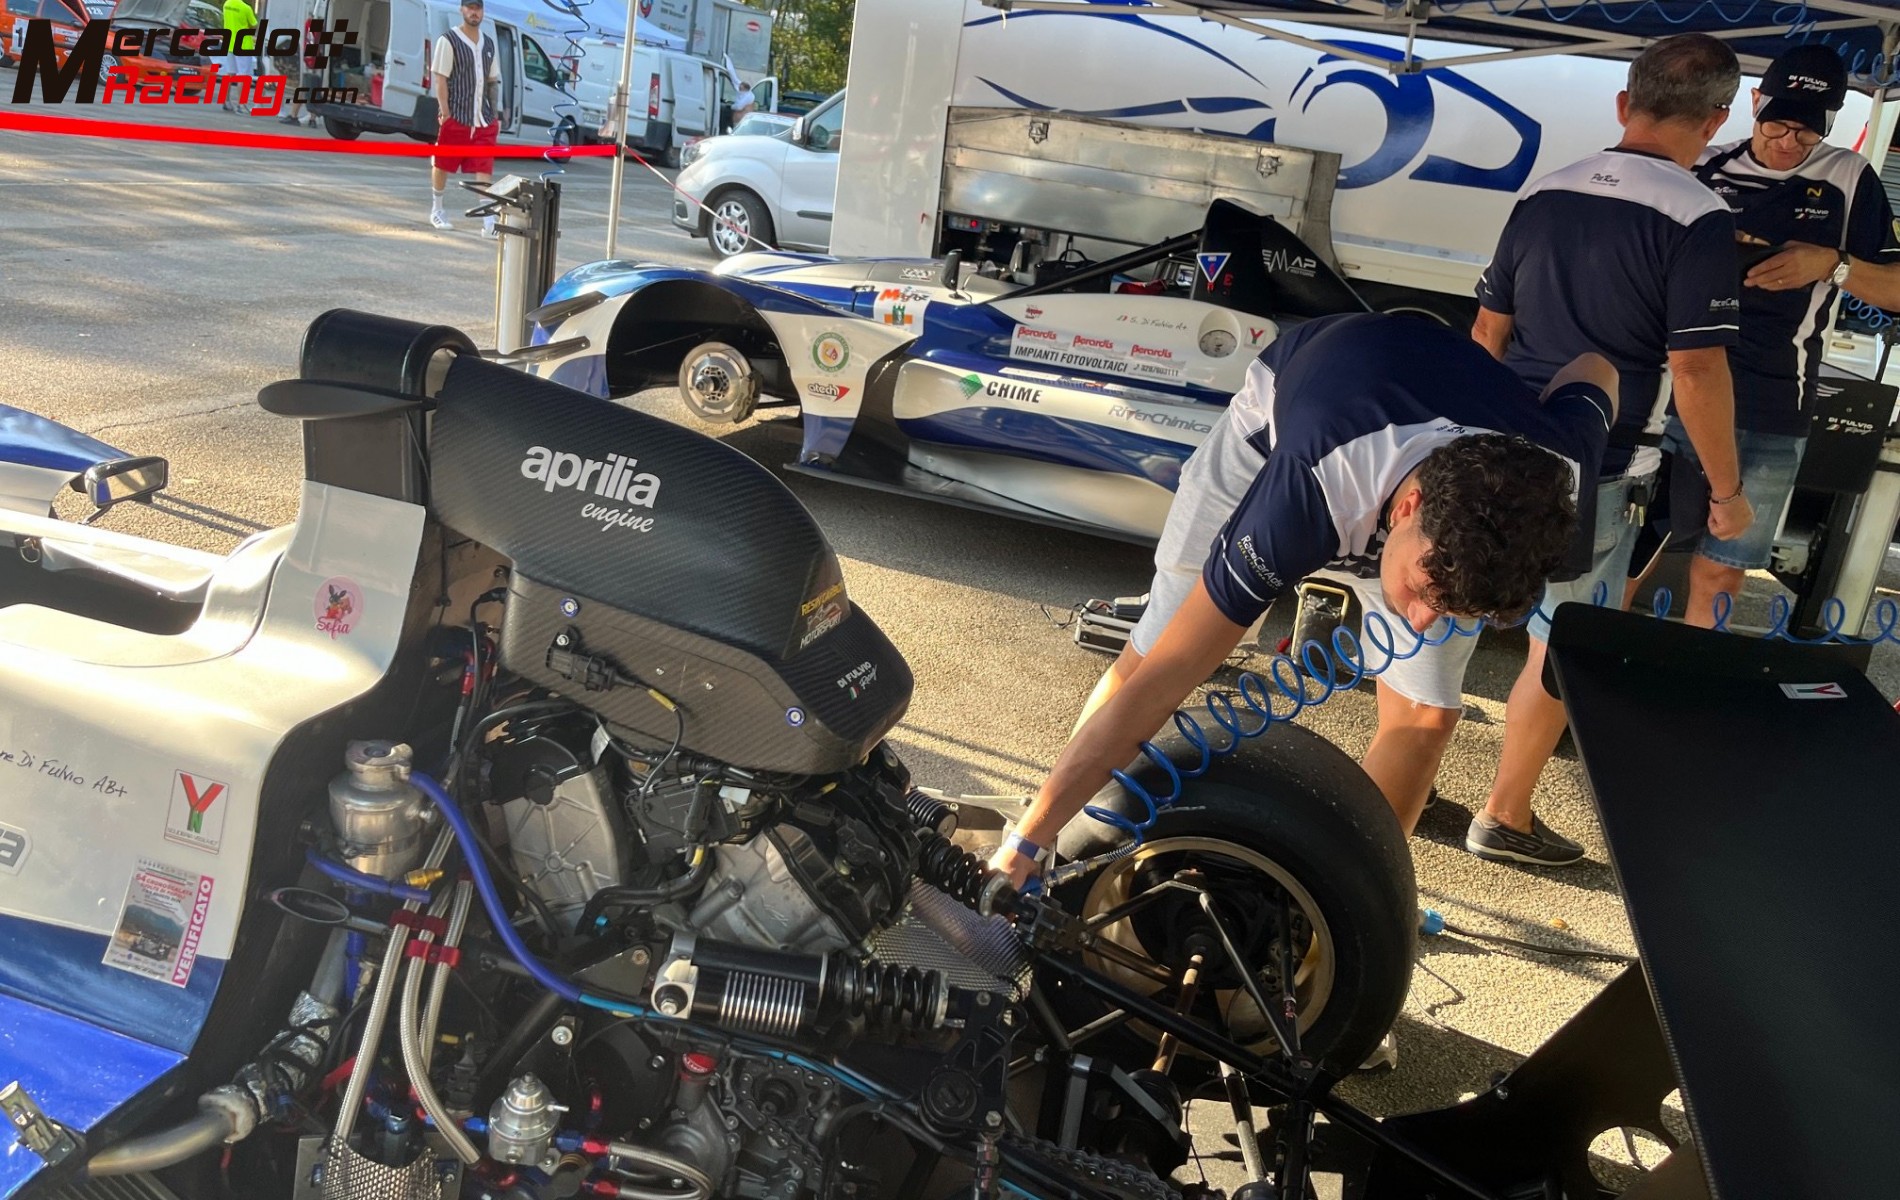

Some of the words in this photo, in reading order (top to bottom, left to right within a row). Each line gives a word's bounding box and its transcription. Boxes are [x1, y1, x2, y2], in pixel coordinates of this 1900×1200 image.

[1015, 346, 1059, 361] IMPIANTI
[1060, 354, 1128, 373] FOTOVOLTAICI
[986, 380, 1043, 403] CHIME
[1108, 404, 1213, 434] RiverChimica
[1840, 418, 1873, 429] FULVIO
[520, 446, 661, 508] aprilia
[581, 503, 655, 532] engine
[316, 616, 350, 640] Sofia
[837, 678, 848, 689] DI
[845, 661, 872, 683] FULVIO
[38, 759, 84, 785] Fulvio
[174, 880, 212, 983] VERIFICATO
